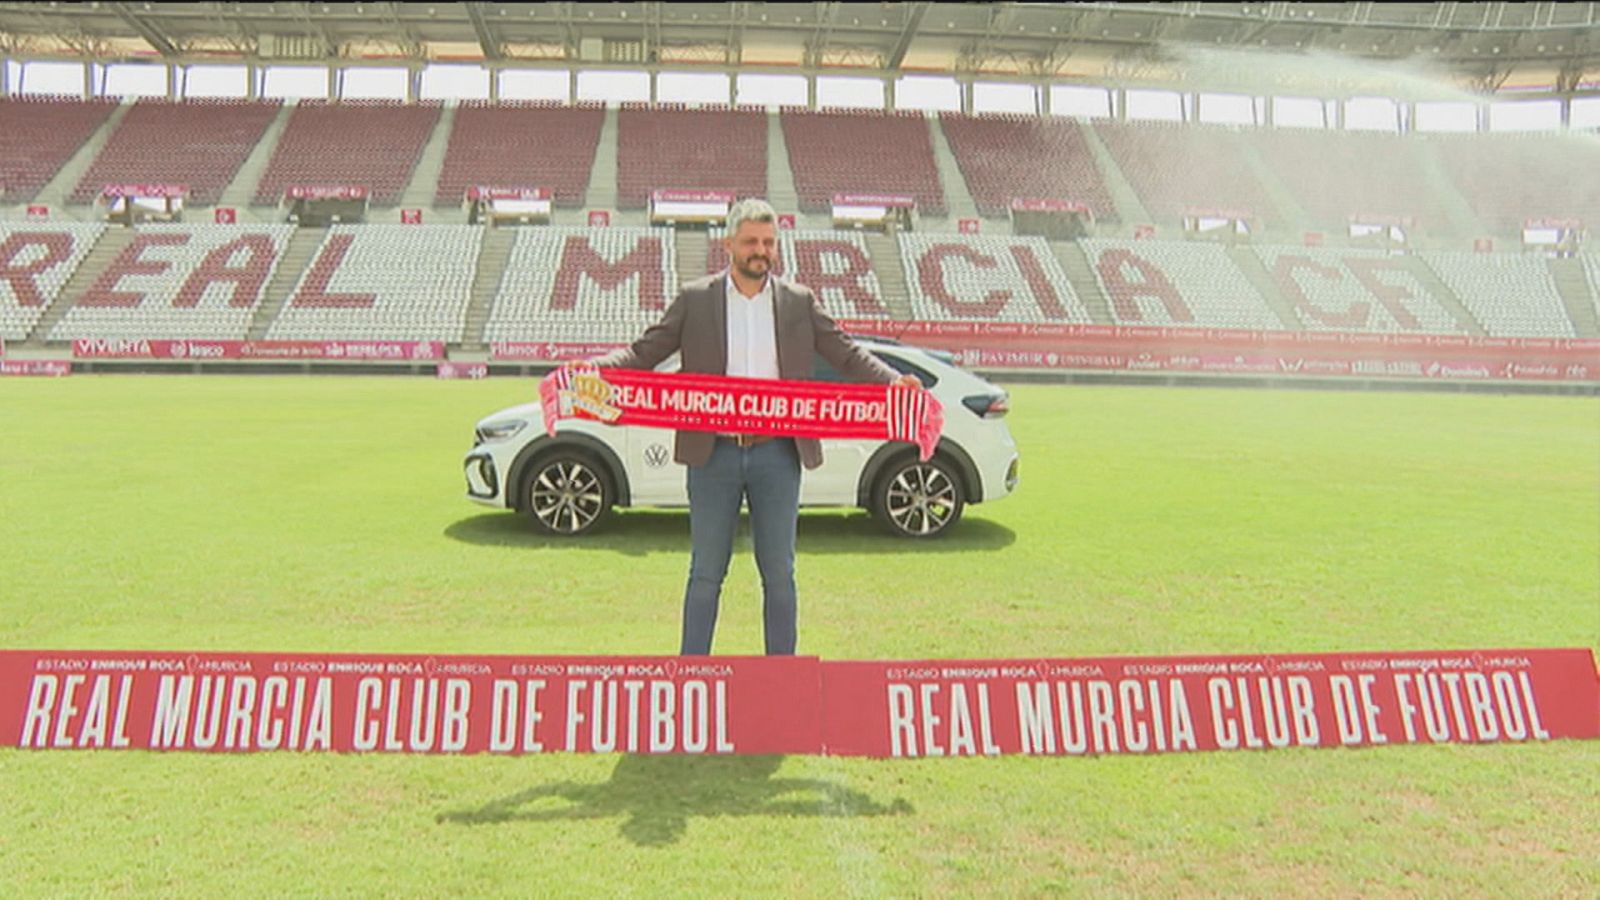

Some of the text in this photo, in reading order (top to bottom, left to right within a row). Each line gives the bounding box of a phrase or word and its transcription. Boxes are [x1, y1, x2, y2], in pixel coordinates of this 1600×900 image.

[611, 385, 658, 410] REAL
[661, 389, 736, 416] MURCIA
[739, 394, 788, 418] CLUB
[792, 398, 817, 420] DE
[819, 393, 887, 423] FÚTBOL
[37, 660, 86, 671] ESTADIO
[150, 659, 184, 671] ROCA
[274, 663, 325, 673] ESTADIO
[387, 663, 423, 674] ROCA
[512, 664, 563, 675] ESTADIO
[627, 664, 664, 675] ROCA
[1124, 664, 1173, 675] ESTADIO
[1230, 663, 1264, 673] ROCA
[1342, 660, 1388, 671] ESTADIO
[1441, 658, 1472, 669] ROCA
[887, 668, 938, 679] ESTADIO
[1001, 666, 1037, 678] ROCA
[20, 669, 734, 754] REAL MURCIA CLUB DE FÚTBOL
[887, 667, 1550, 757] REAL MURCIA CLUB DE FÚTBOL
